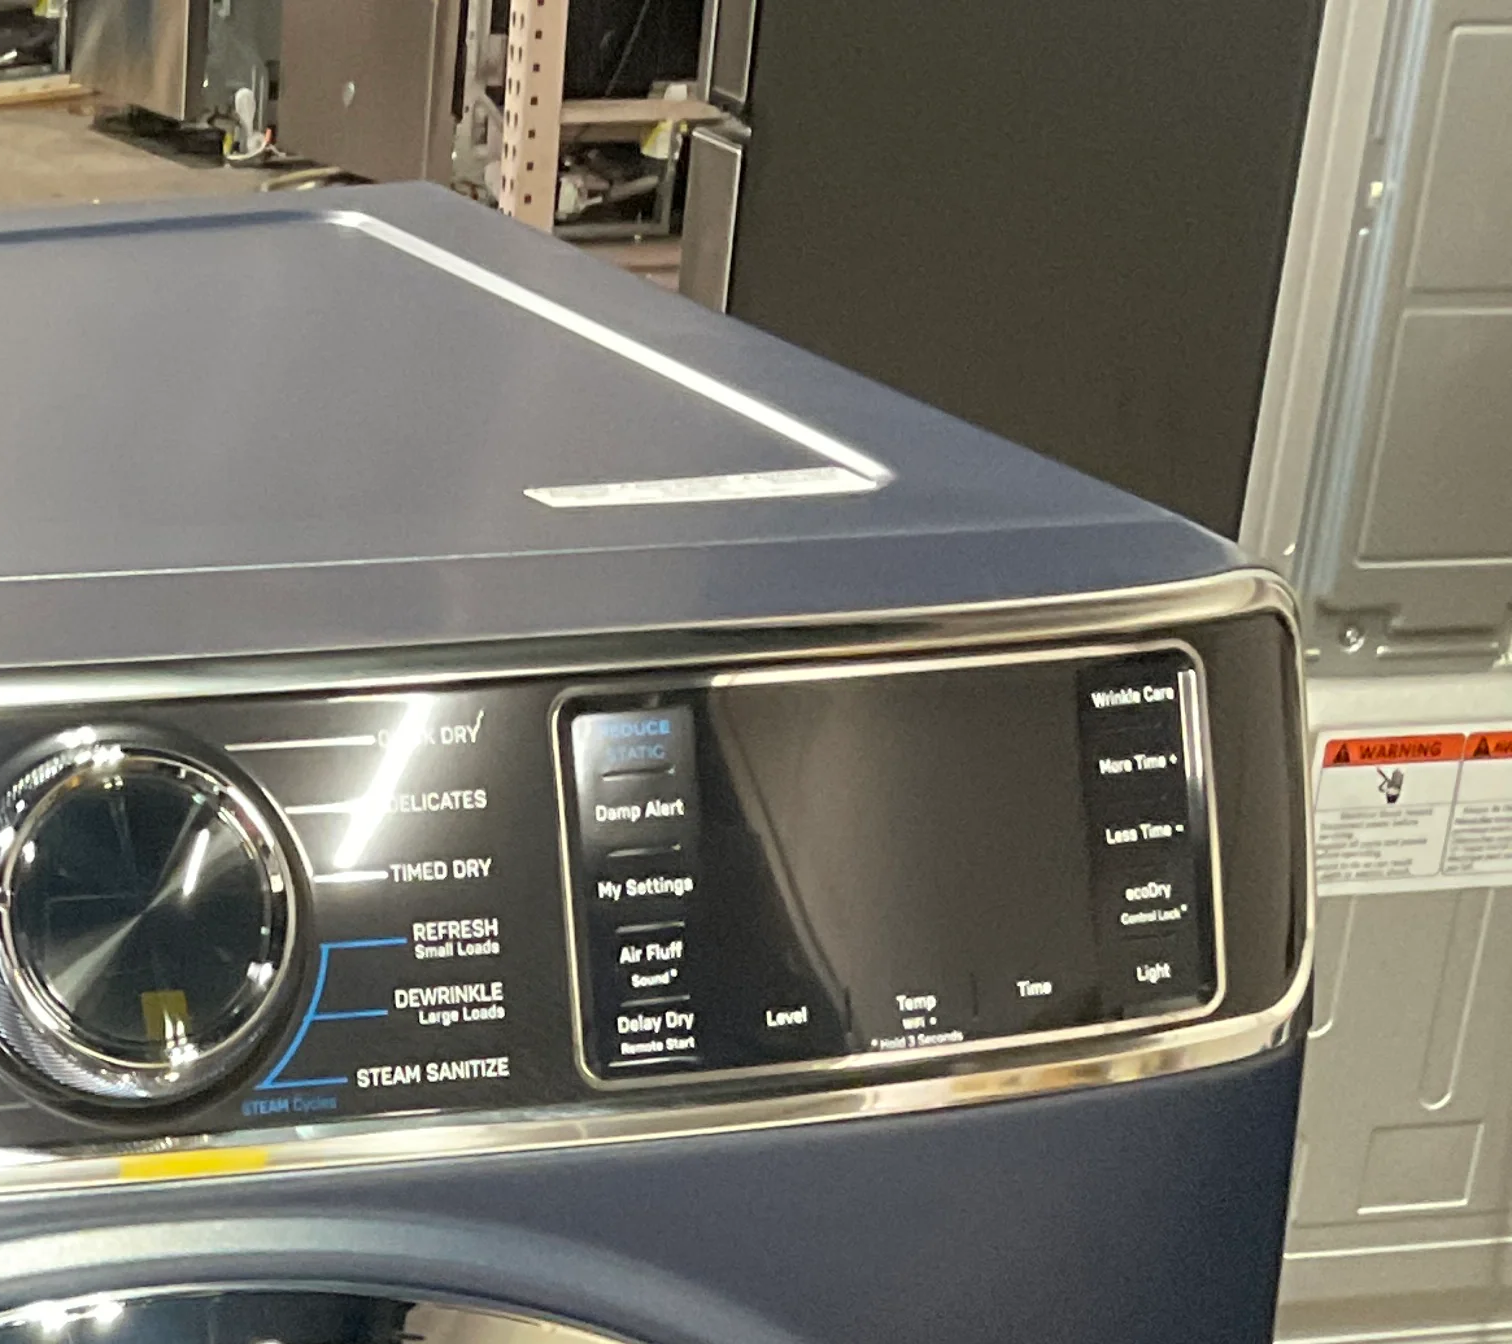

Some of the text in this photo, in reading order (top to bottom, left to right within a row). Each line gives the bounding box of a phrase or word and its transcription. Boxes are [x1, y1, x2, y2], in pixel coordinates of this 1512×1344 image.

[1091, 685, 1175, 708] Wrinkle Care
[1359, 742, 1443, 760] WARNING
[1098, 758, 1133, 775] More
[1134, 754, 1167, 770] Time
[390, 789, 488, 813] DELICATES
[595, 798, 685, 823] Damp Alert
[1105, 828, 1138, 845] Less
[1139, 823, 1172, 840] Time
[390, 857, 492, 883] TIMED DRY
[597, 877, 694, 901] My Settings
[413, 918, 498, 942] REFRESH
[414, 939, 500, 960] Small Loads
[619, 940, 684, 964] Air Fluff
[1136, 963, 1171, 984] Light
[394, 982, 504, 1009] DEWRINKLE
[1017, 979, 1052, 998] Time
[895, 994, 937, 1012] Temp
[419, 1004, 505, 1027] Large Loads
[617, 1011, 695, 1034] Delay Dry
[766, 1006, 807, 1027] Level
[620, 1036, 695, 1055] Remote Start
[356, 1057, 509, 1088] STEAM SANITIZE
